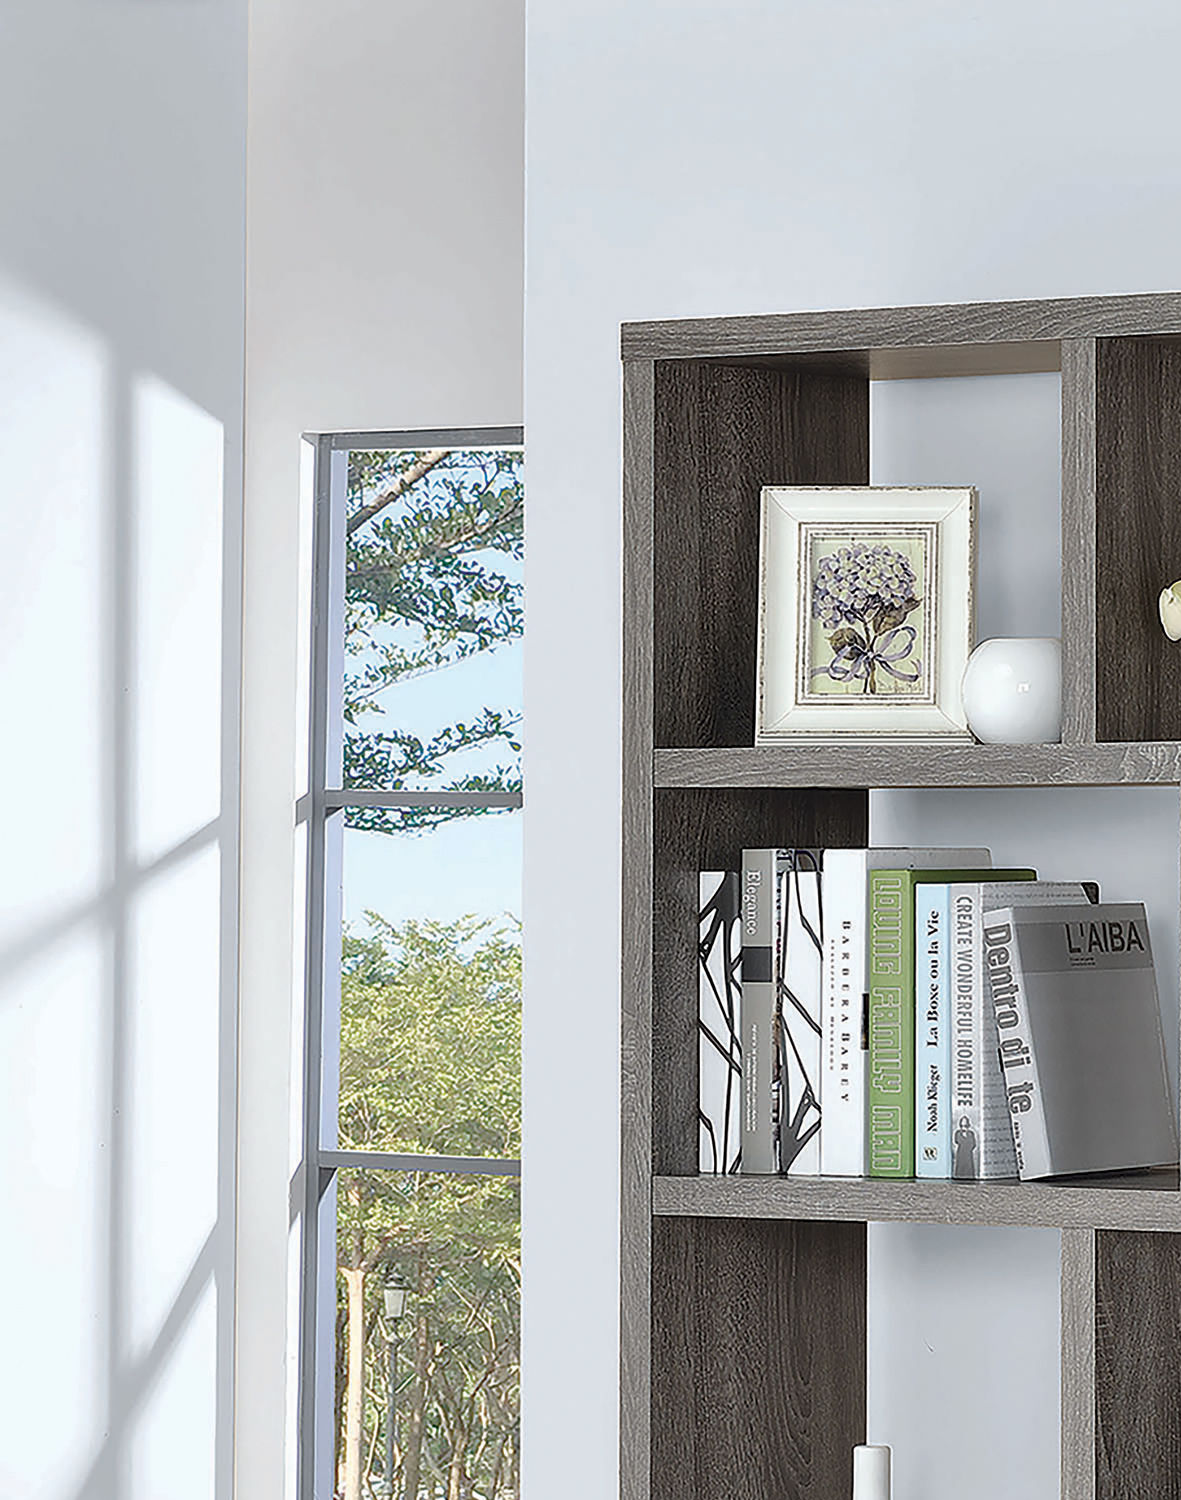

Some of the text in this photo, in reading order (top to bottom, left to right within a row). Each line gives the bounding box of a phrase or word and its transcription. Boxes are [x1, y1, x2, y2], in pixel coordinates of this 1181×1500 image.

[745, 868, 762, 936] Elegance
[1065, 921, 1145, 954] L'AIBA
[927, 911, 940, 1047] La Boxe ou la Vie
[956, 896, 973, 1107] CREATE WONDERFUL HOMELIFE
[983, 923, 1019, 1031] Dentro
[872, 986, 902, 1093] FAMILY
[1000, 1037, 1031, 1068] di
[926, 1101, 939, 1132] Noah
[1009, 1081, 1036, 1115] te
[872, 1105, 902, 1171] MAN
